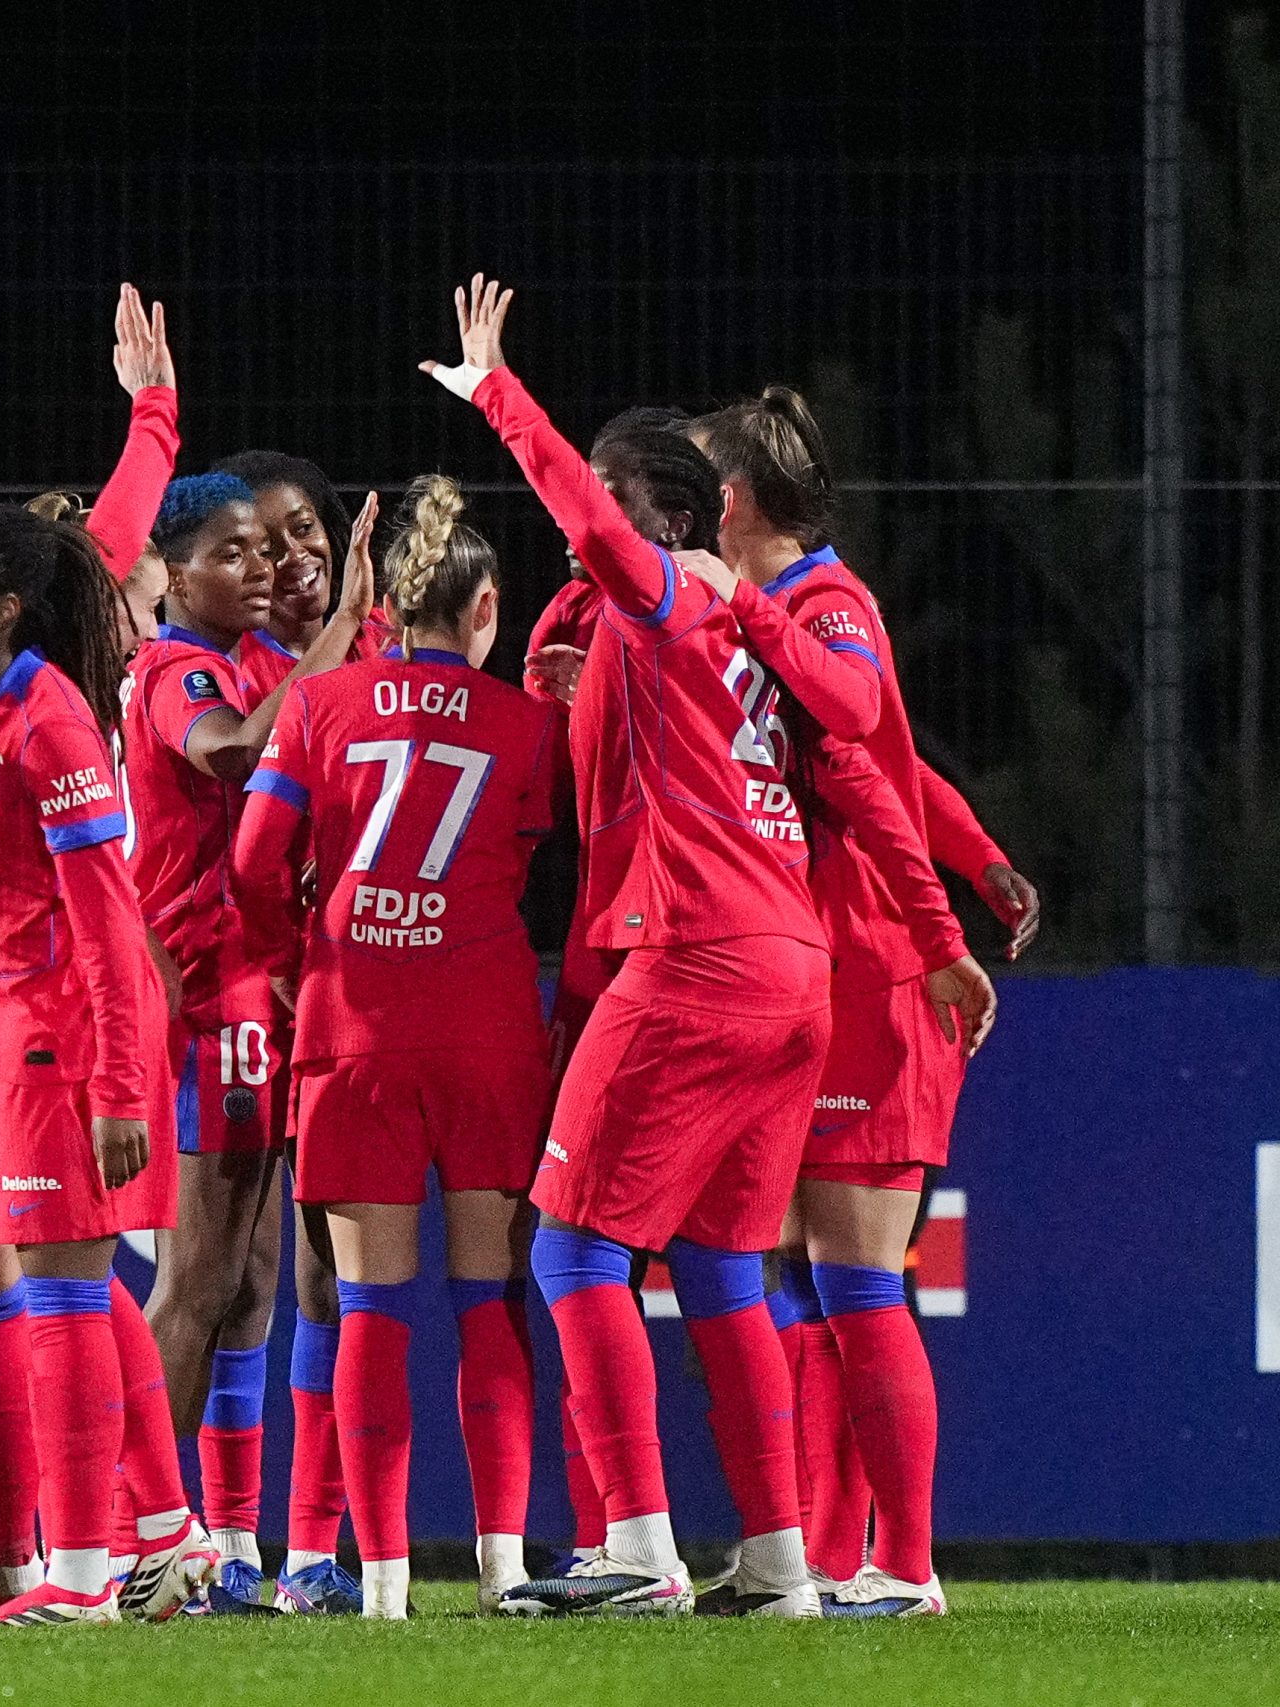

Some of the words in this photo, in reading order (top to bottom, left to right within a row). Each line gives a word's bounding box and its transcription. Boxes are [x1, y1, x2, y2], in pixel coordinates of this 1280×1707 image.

[373, 680, 470, 723] OLGA
[51, 766, 99, 794] VISIT
[40, 782, 114, 817] RWANDA
[345, 738, 497, 882] 77
[351, 922, 443, 948] UNITED
[220, 1021, 270, 1086] 10
[813, 1094, 871, 1110] eloitte.
[1, 1175, 63, 1191] Deloitte.
